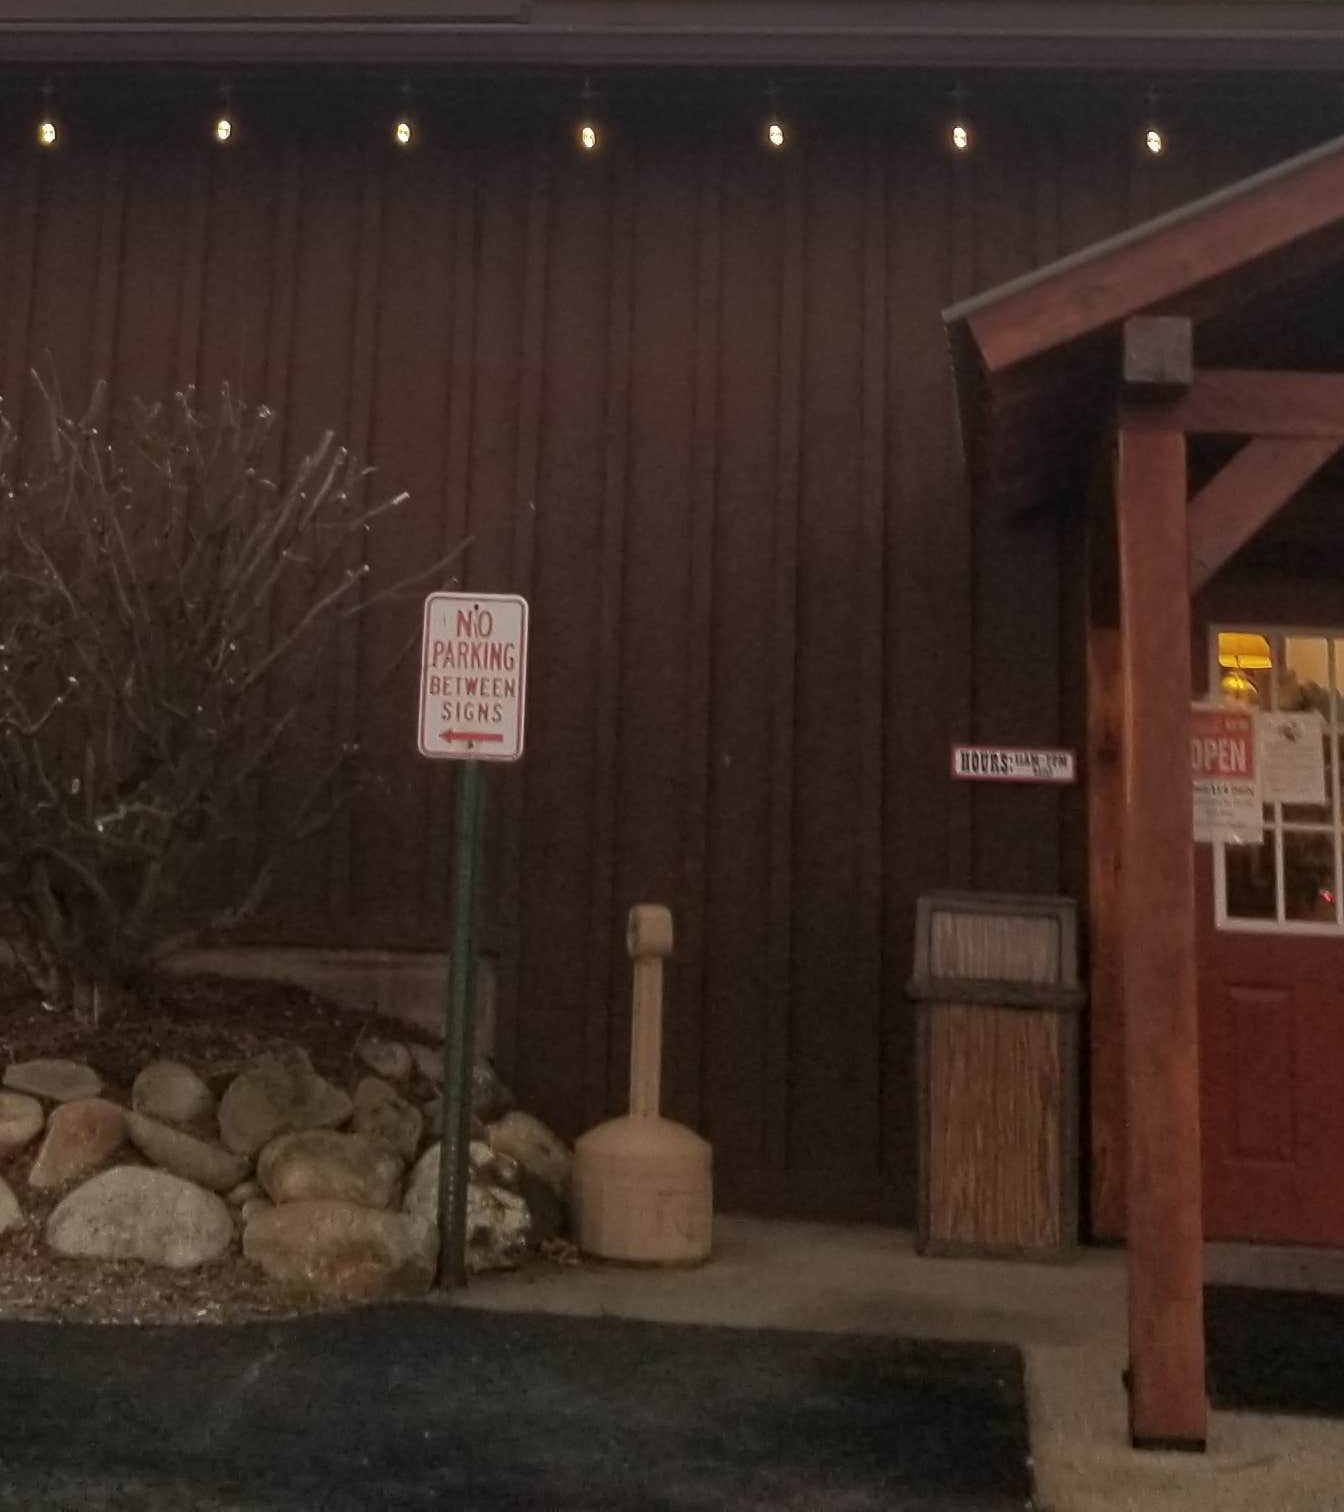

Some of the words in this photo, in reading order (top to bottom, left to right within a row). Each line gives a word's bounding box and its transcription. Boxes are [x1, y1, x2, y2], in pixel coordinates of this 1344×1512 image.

[456, 609, 494, 638] NO
[432, 639, 516, 671] PARKING
[429, 675, 516, 698] BETWEEN
[441, 701, 504, 724] SIGNS
[1191, 737, 1247, 773] OPEN
